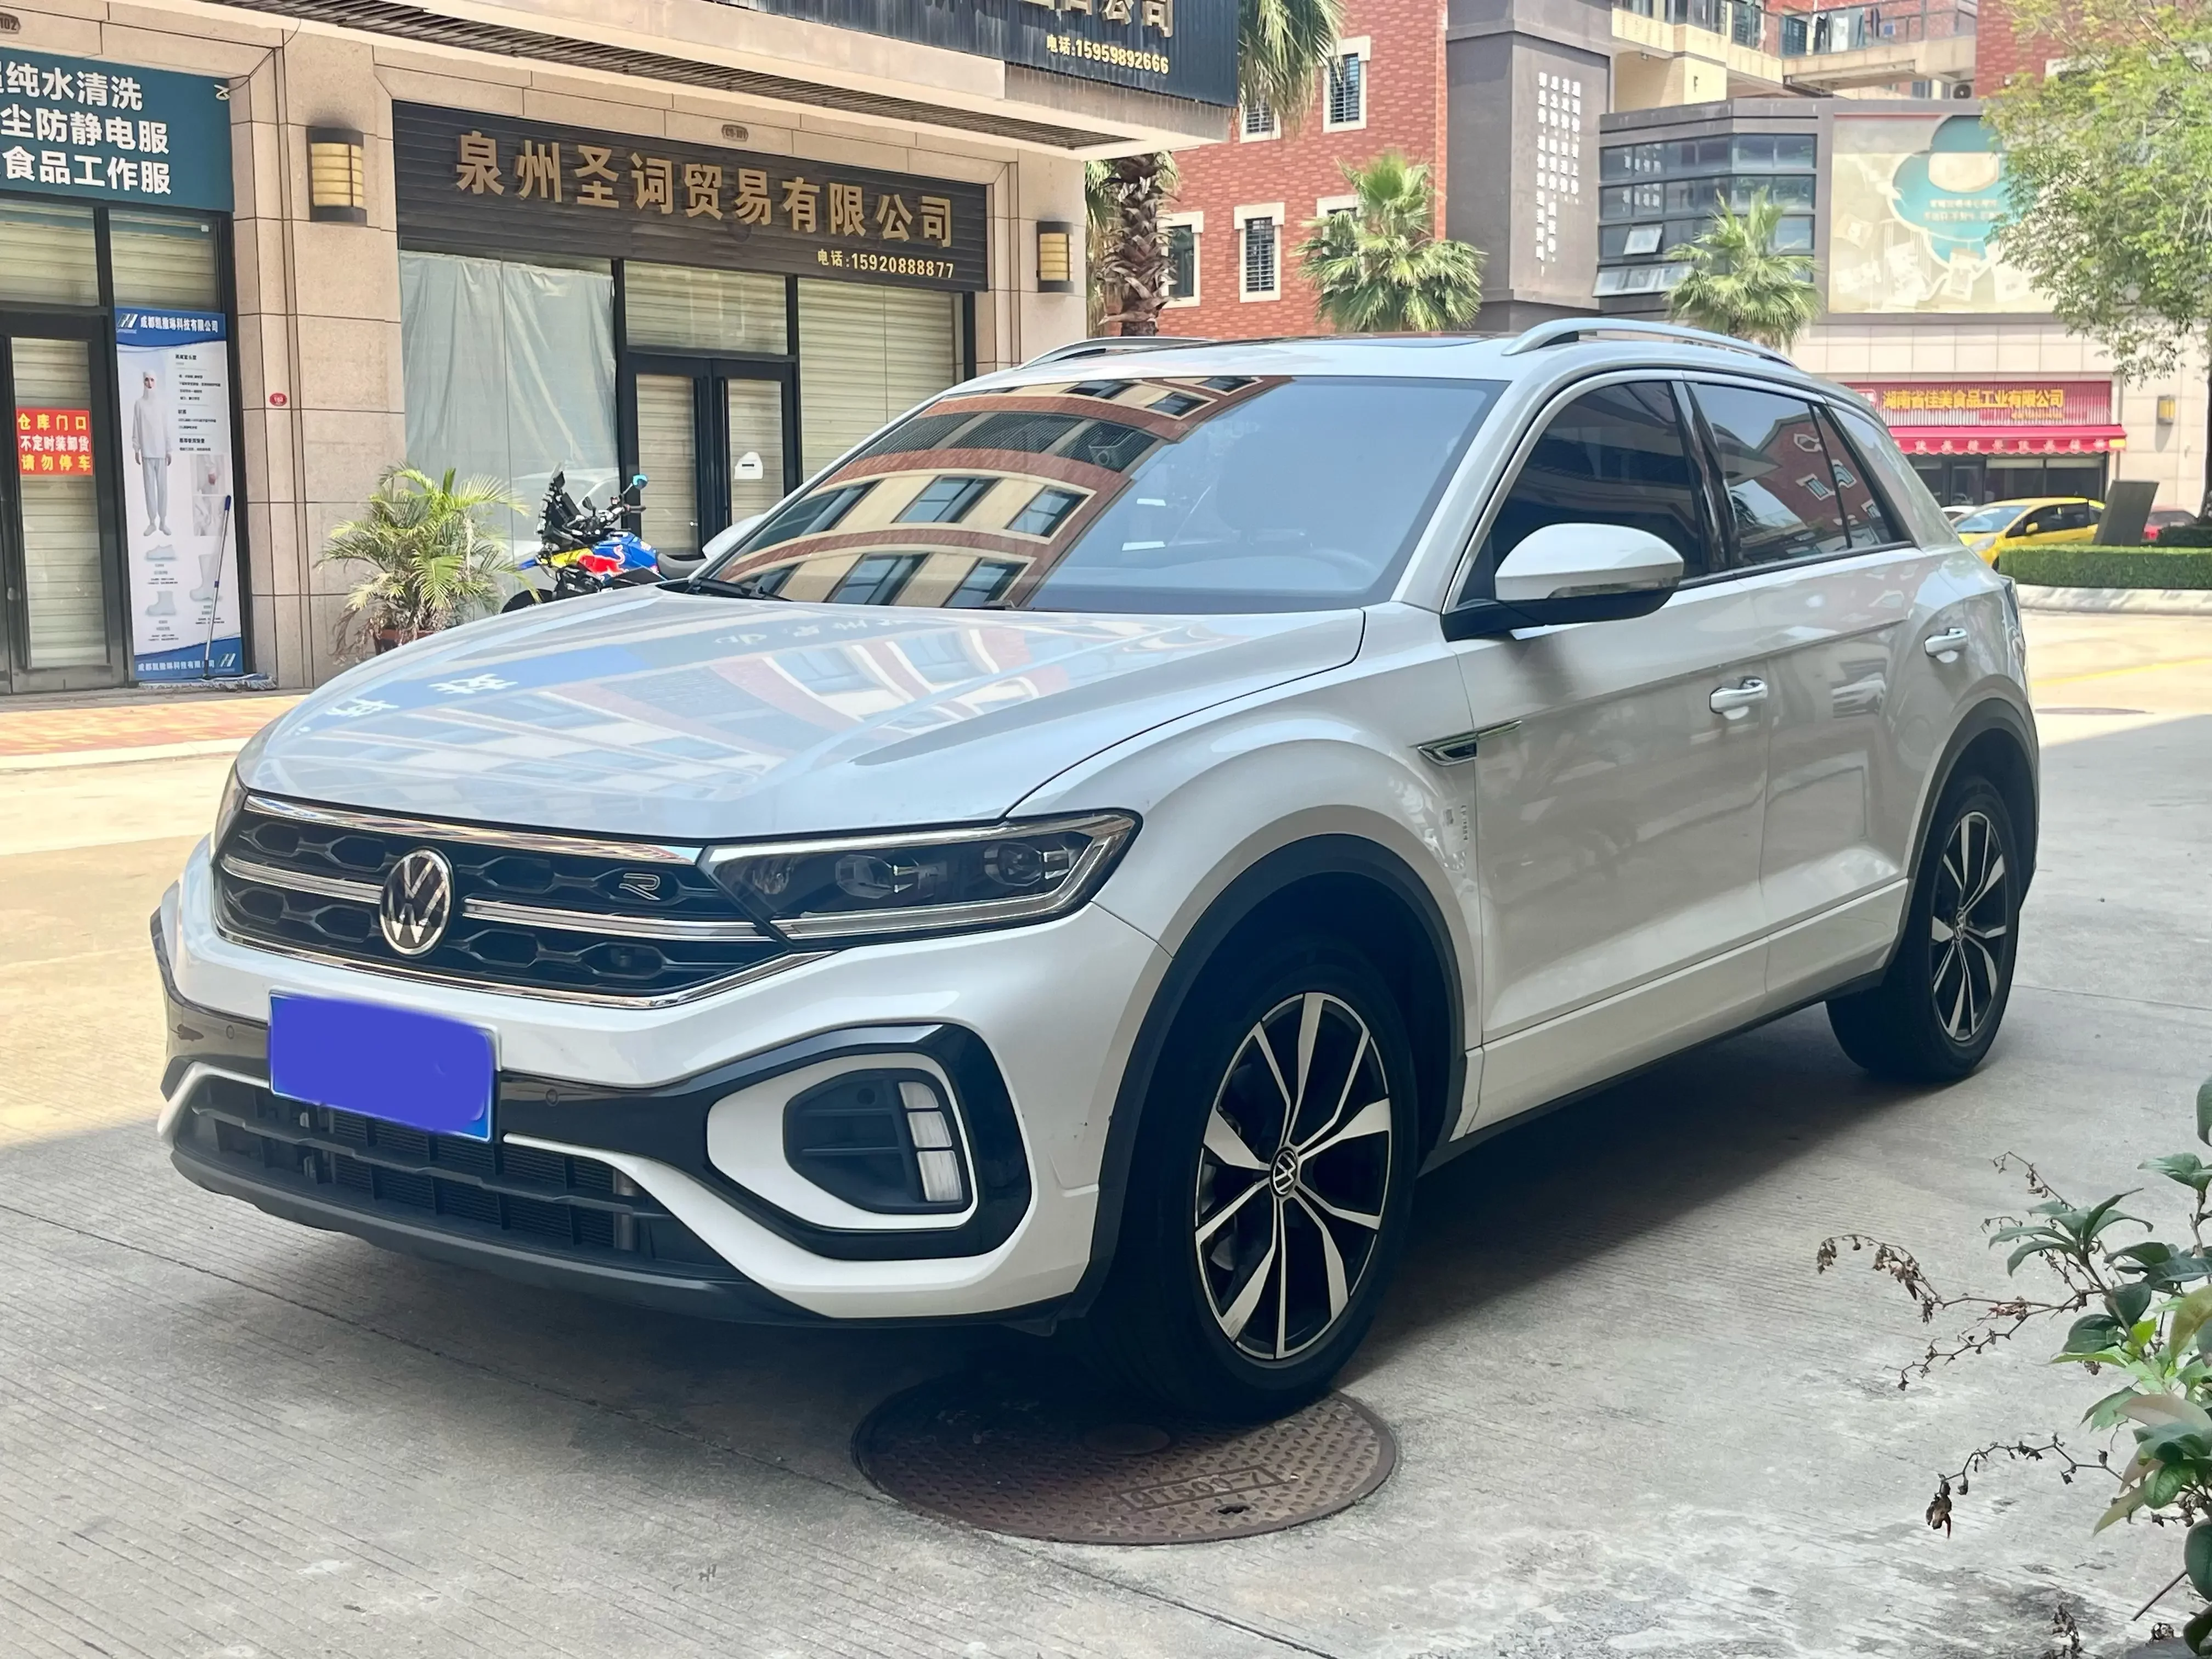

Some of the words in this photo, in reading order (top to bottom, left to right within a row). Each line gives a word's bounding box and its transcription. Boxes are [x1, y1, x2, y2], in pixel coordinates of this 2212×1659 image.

[1046, 33, 1169, 74] 电话:15959892666
[0, 61, 143, 111] 纯水清洗
[1, 103, 170, 154] 尘防静电服
[2, 145, 171, 195] 食品工作服
[456, 131, 952, 248] 泉州圣词贸易有限公司
[817, 249, 953, 279] 电话:15920888877
[18, 413, 87, 431] 仓库门口
[20, 435, 89, 452] 不定时装卸货
[21, 454, 91, 471] 请勿停车
